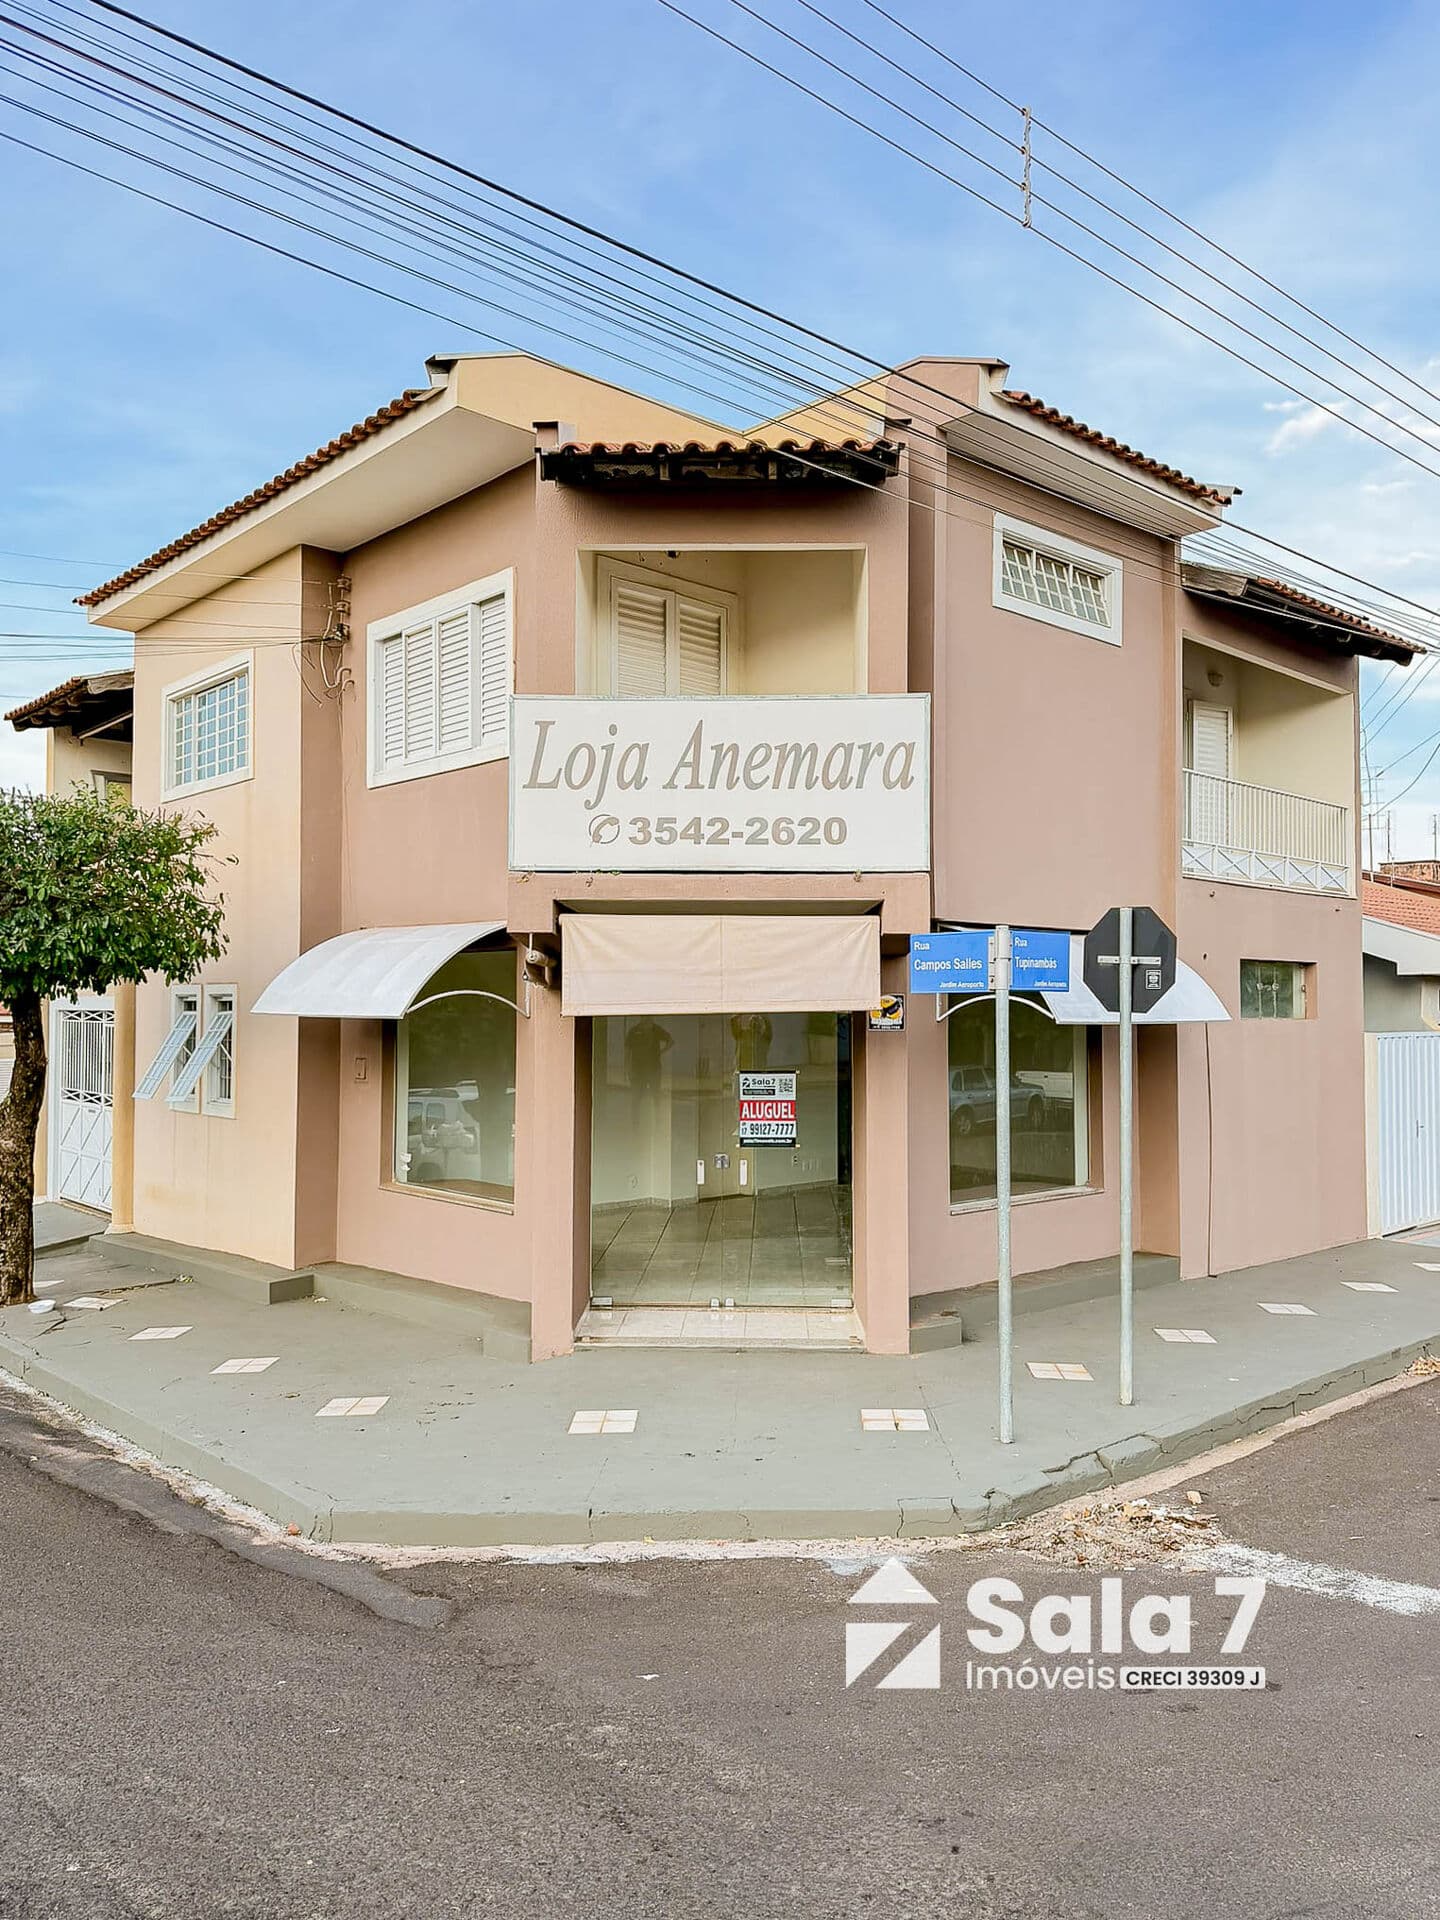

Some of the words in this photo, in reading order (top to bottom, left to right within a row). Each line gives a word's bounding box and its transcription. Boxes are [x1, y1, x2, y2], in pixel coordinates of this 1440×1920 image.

[522, 719, 649, 809] Loja
[662, 718, 916, 791] Anemara
[628, 815, 848, 846] 3542-2620
[914, 941, 930, 951] Rua
[1015, 937, 1028, 947] Rua
[914, 959, 951, 972] Campos
[953, 958, 983, 970] Salles
[1015, 956, 1057, 971] Tupinambás
[742, 1102, 795, 1119] ALUGUEL
[750, 1123, 795, 1135] 99127-7777
